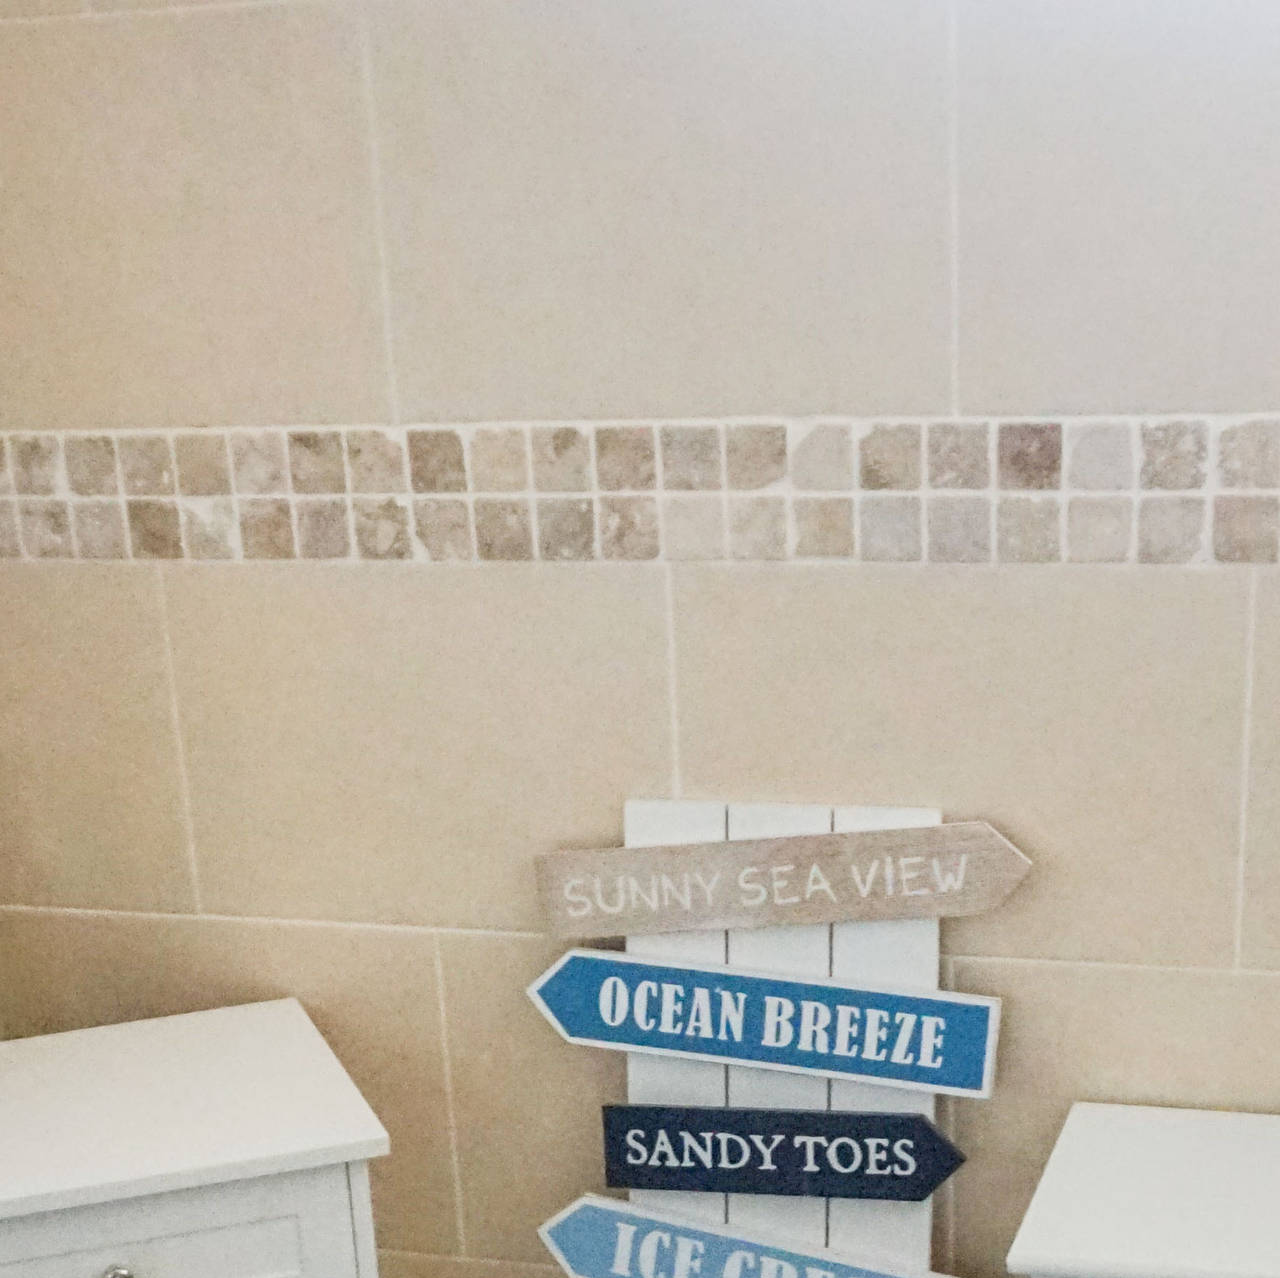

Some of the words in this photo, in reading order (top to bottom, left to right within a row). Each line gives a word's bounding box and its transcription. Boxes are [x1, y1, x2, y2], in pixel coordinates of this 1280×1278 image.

[563, 871, 721, 917] SUNNY
[738, 863, 837, 906] SEA
[851, 854, 970, 898] VIEW
[598, 976, 746, 1042] OCEAN
[761, 996, 946, 1068] BREEZE
[626, 1129, 785, 1170] SANDY
[794, 1135, 917, 1176] TOES
